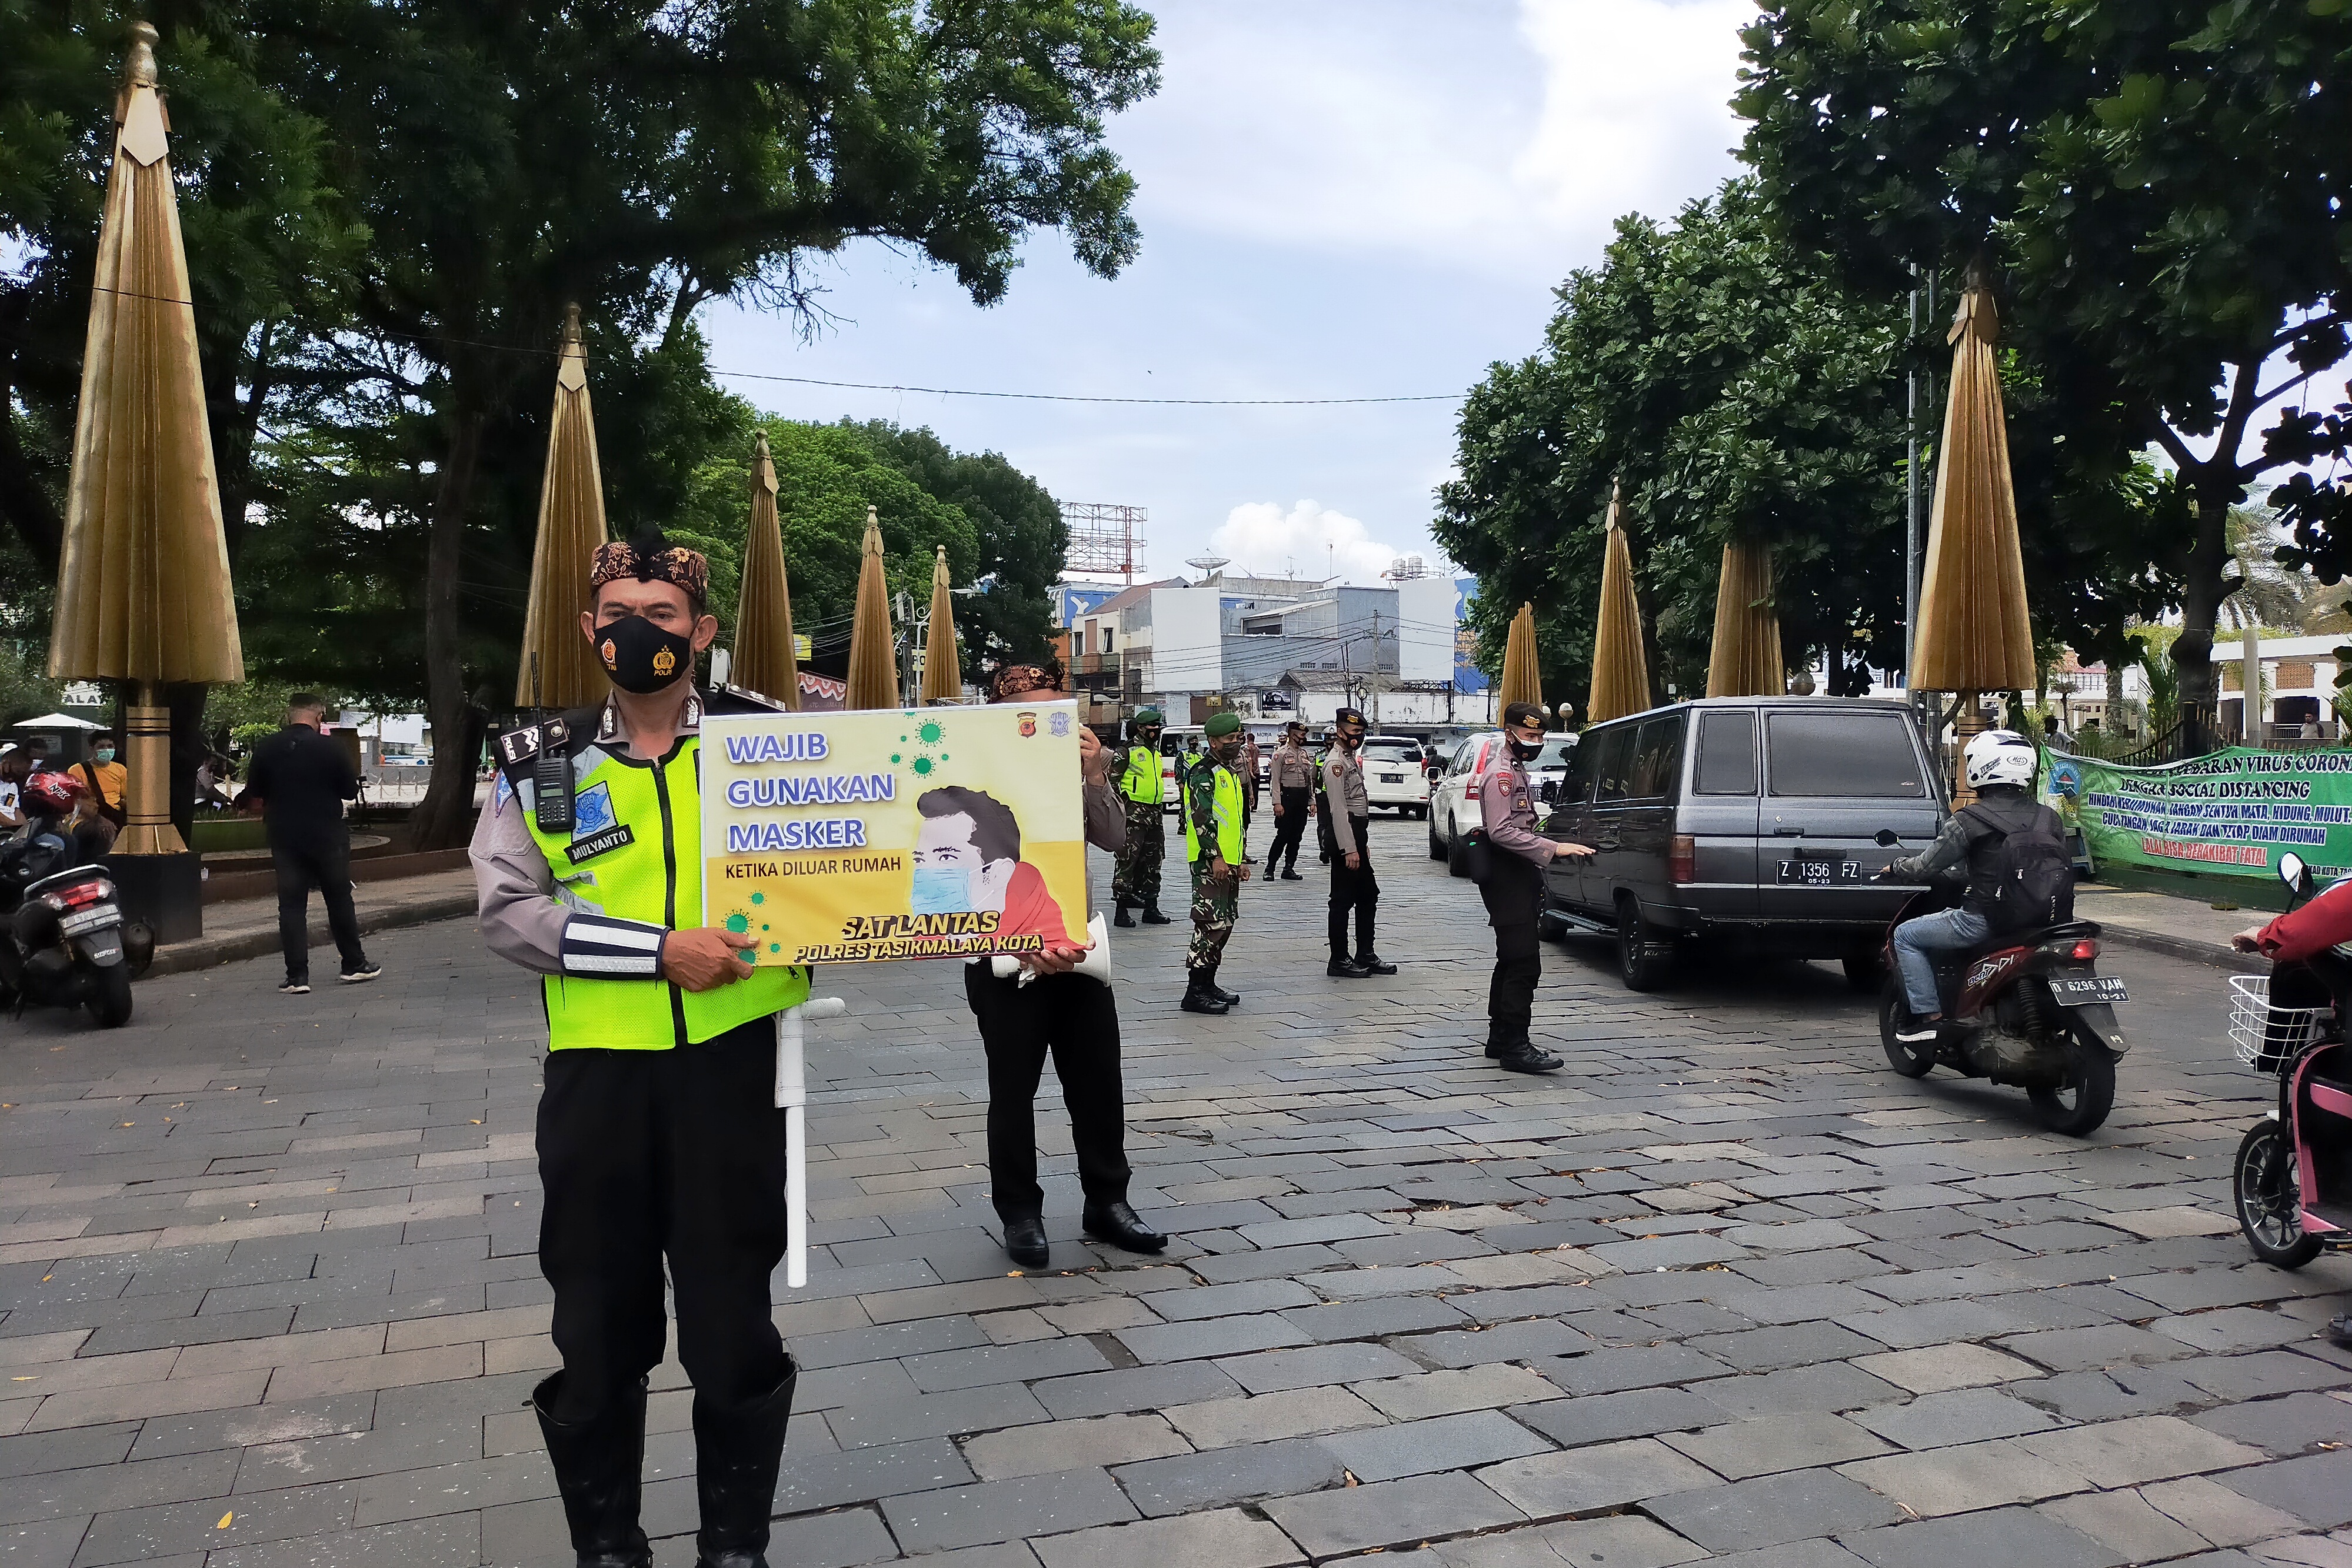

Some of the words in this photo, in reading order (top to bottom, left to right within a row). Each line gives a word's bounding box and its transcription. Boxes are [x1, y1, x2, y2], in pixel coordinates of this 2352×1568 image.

[504, 736, 517, 760] POLISI
[725, 733, 828, 761] WAJIB
[2247, 756, 2293, 772] VIRUS
[2296, 754, 2352, 772] CORON
[48, 782, 71, 800] NHK
[727, 773, 894, 806] GUNAKAN
[2120, 778, 2166, 796] DENGAN
[2168, 782, 2216, 798] SOCIAL
[2220, 781, 2310, 798] DISTANCING
[2203, 804, 2238, 818] SENTUH
[2241, 805, 2270, 820] MATA,
[2273, 806, 2312, 822] HIDUNG,
[2314, 806, 2351, 823] MULUT.
[728, 819, 865, 850] MASKER
[2103, 813, 2120, 826] CUCI
[2170, 820, 2200, 836] JARAK
[2200, 823, 2220, 838] DAN
[2221, 825, 2250, 839] TETAP
[2252, 825, 2278, 841] DIAM
[2279, 826, 2326, 845] DIRUMAH
[572, 830, 628, 860] MULYANTO
[2163, 840, 2184, 858] BISA
[2186, 842, 2238, 862] BERAKIBAT
[2239, 846, 2267, 866] FATAL
[726, 862, 778, 879] KETIKA
[783, 860, 838, 876] DILUAR
[842, 857, 901, 873] RUMAH
[1781, 862, 1789, 876] Z
[1801, 862, 1830, 877] 1356
[1842, 863, 1858, 878] FZ
[2321, 866, 2338, 876] KOTA
[795, 943, 871, 962] POLRES
[874, 937, 993, 959] TASIKMALAYA
[996, 935, 1044, 954] KOTA
[2068, 980, 2096, 992] 6296
[2098, 978, 2124, 990] VAH
